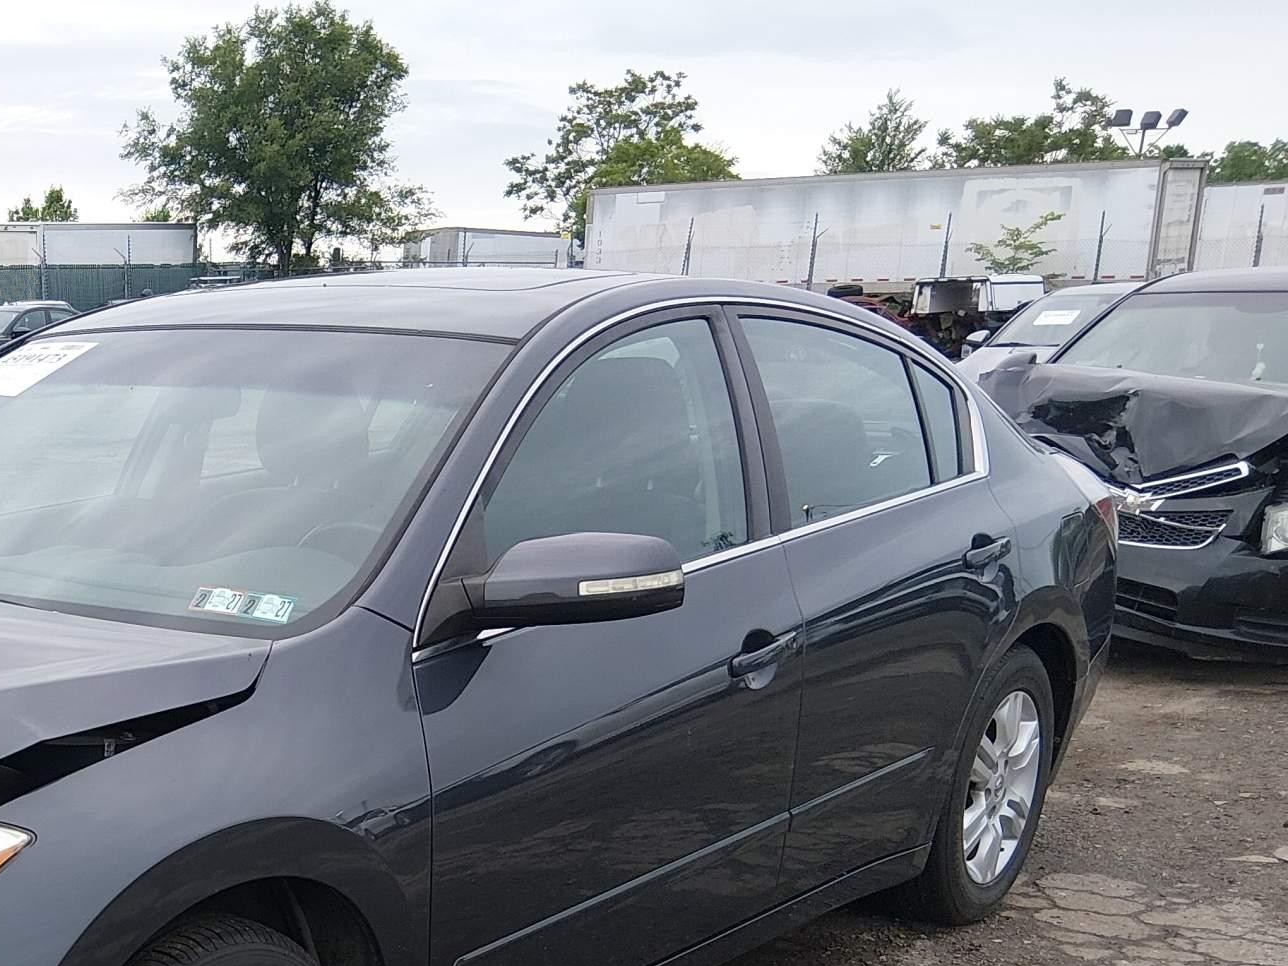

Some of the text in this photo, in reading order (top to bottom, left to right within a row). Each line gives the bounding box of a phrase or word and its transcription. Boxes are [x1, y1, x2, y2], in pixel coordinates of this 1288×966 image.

[195, 593, 207, 608] 2
[226, 593, 243, 612] 27
[243, 600, 256, 615] 2
[275, 600, 292, 618] 27
